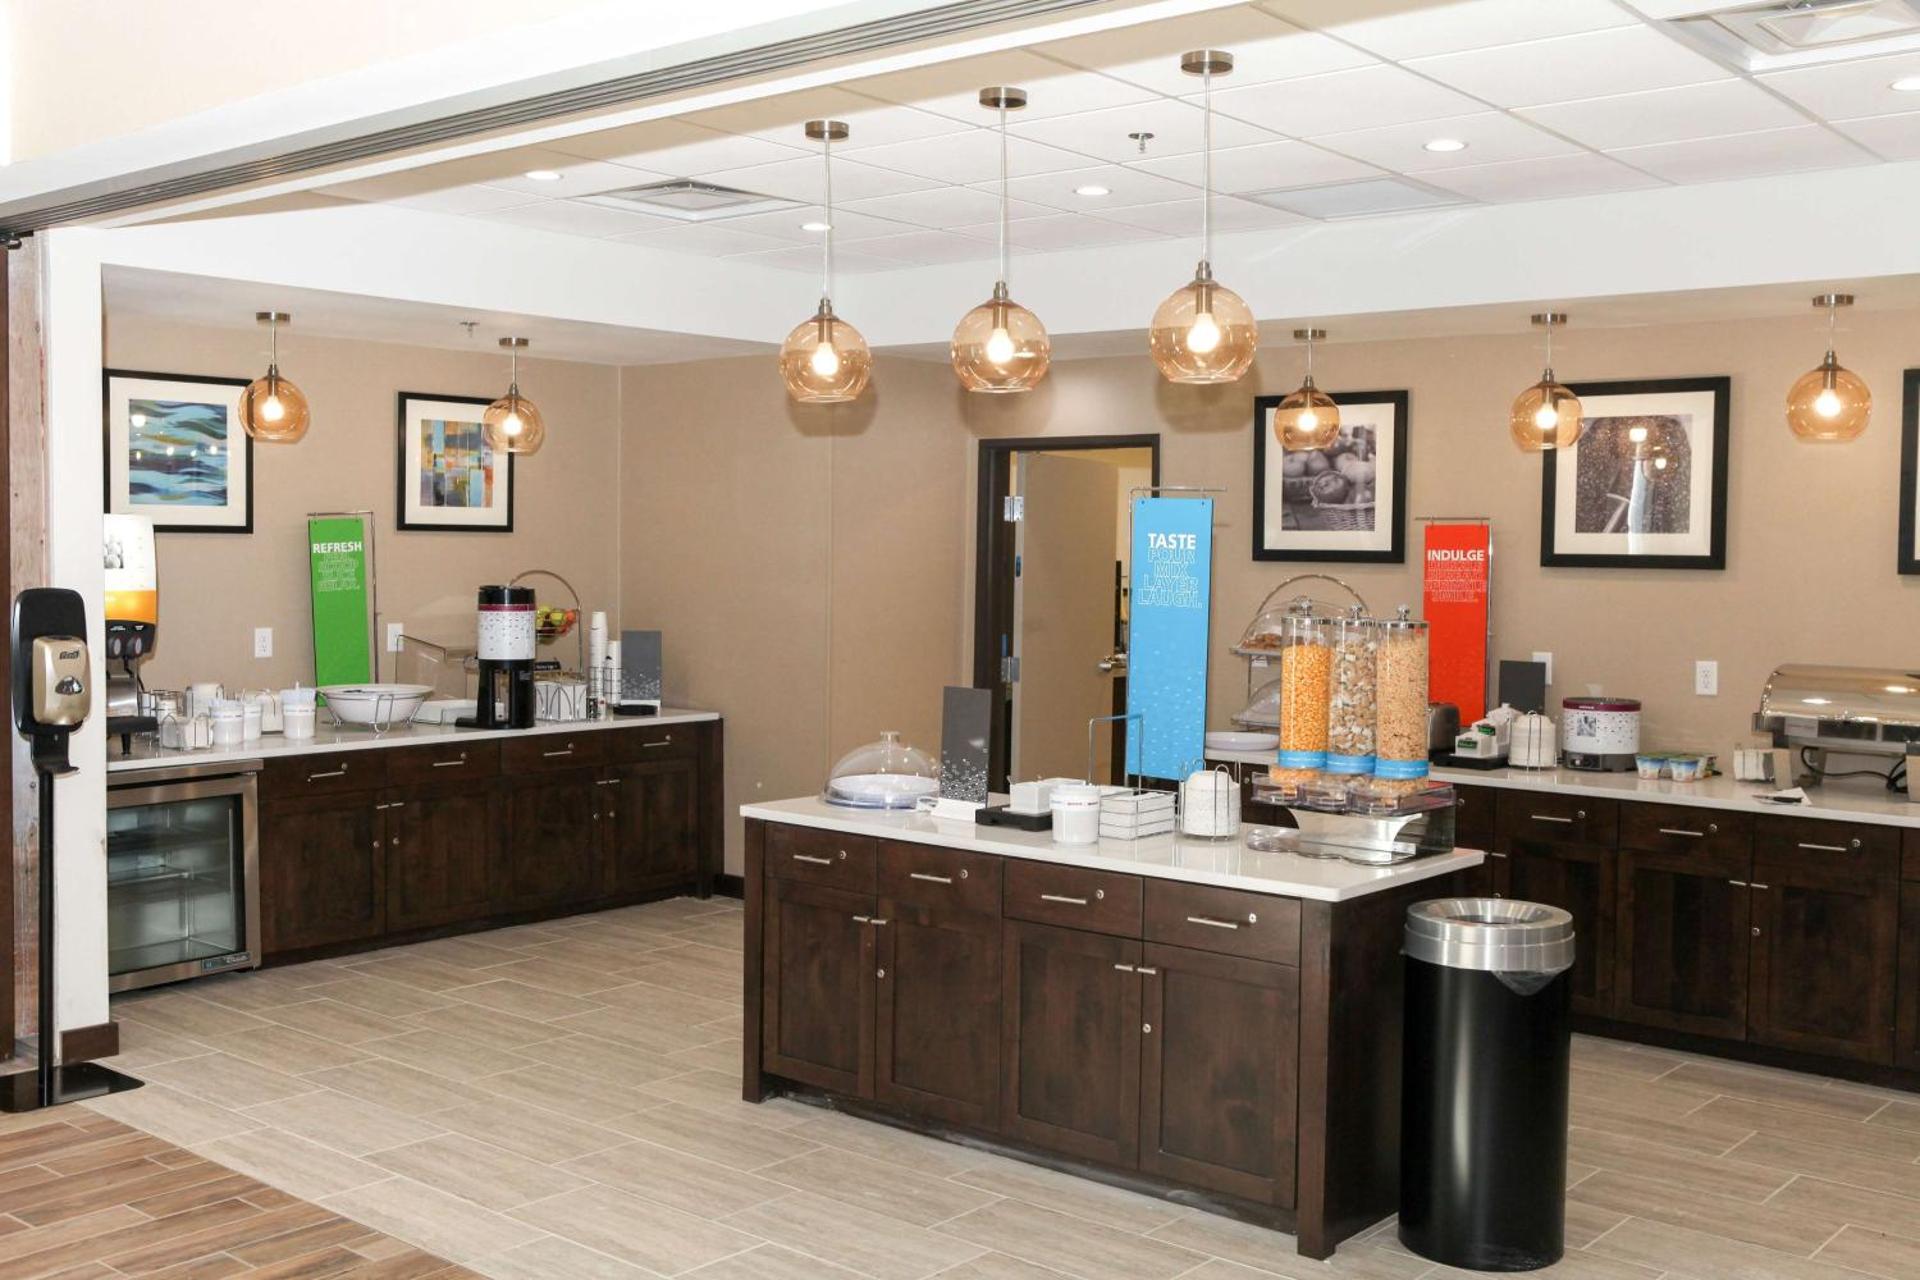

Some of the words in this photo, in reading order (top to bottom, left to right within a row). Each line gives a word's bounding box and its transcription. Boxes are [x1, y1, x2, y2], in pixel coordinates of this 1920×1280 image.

[312, 541, 362, 554] REFRESH
[1147, 533, 1197, 550] TASTE
[1427, 549, 1485, 561] INDULGE
[1154, 560, 1190, 577] MIX
[1143, 574, 1199, 593] LAYER
